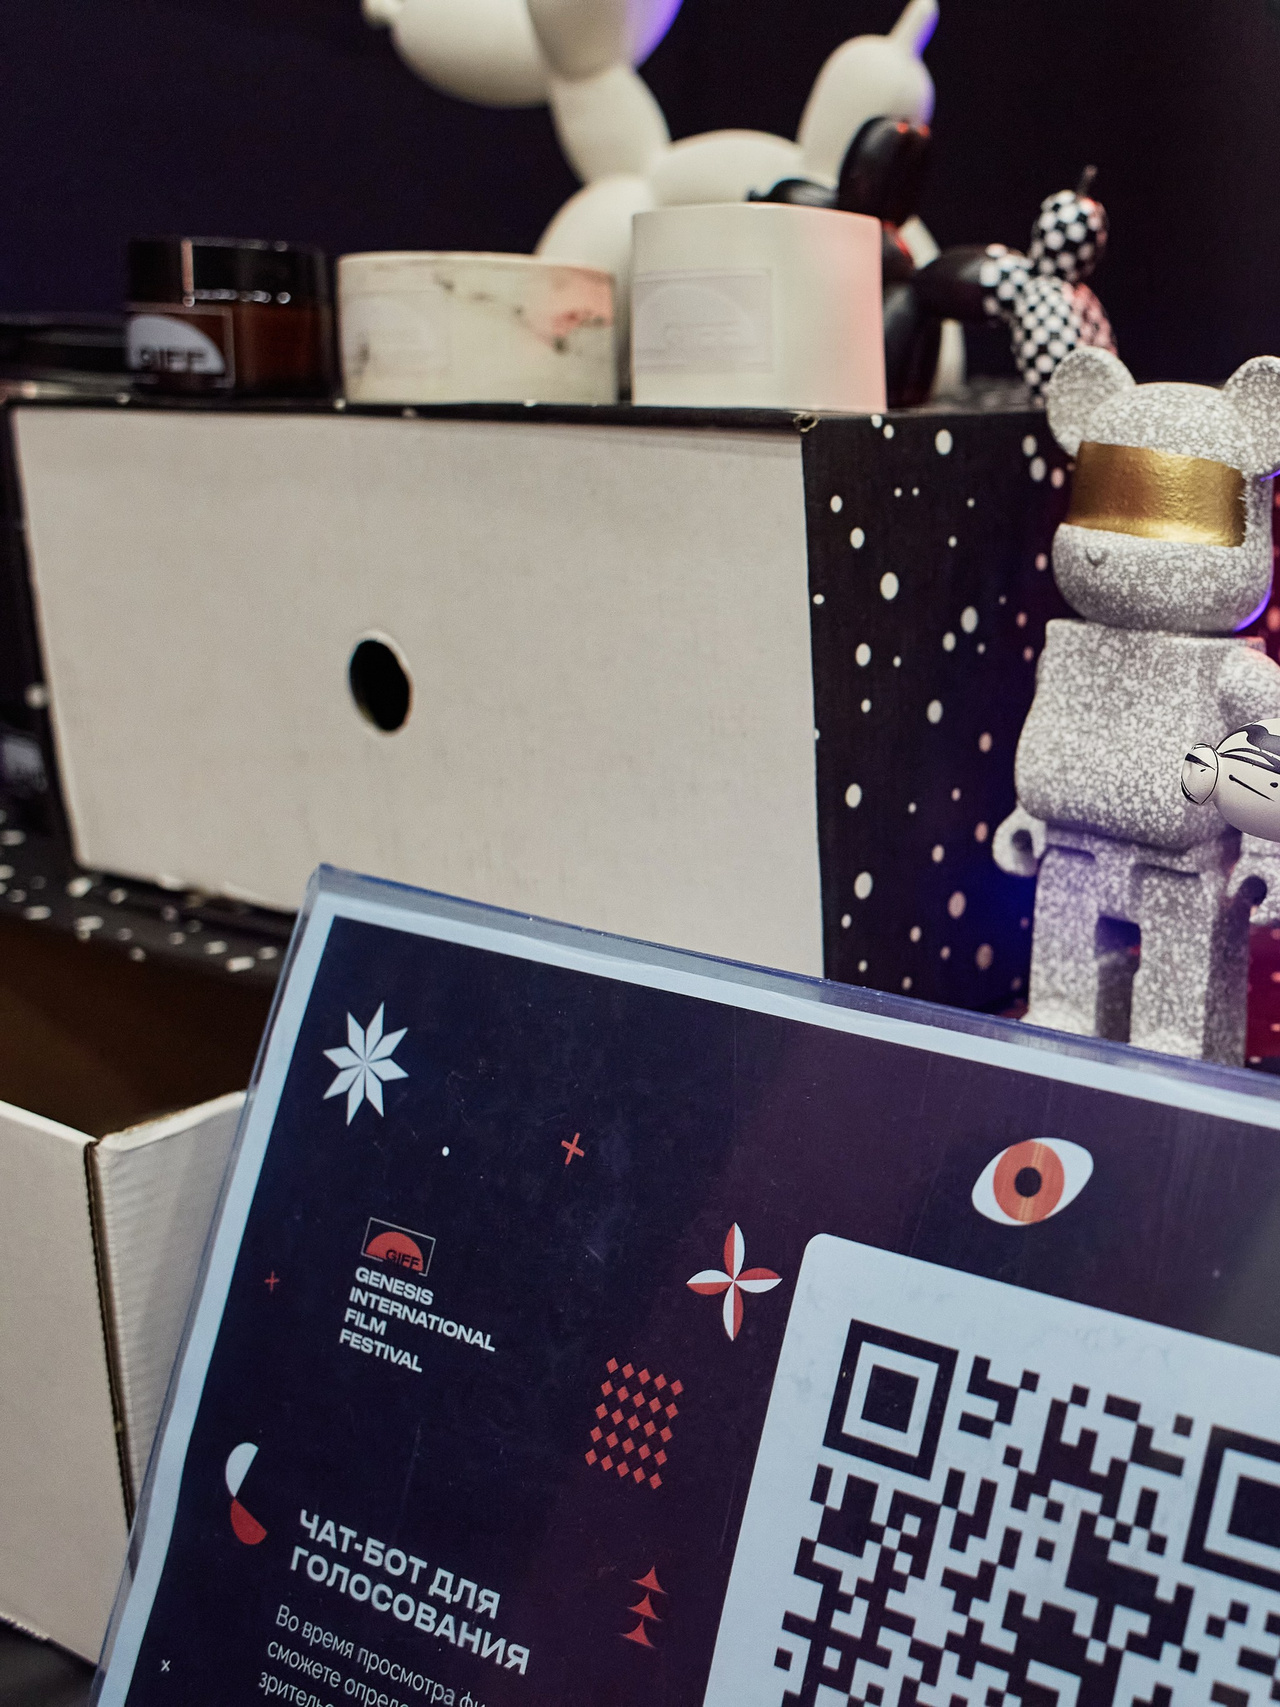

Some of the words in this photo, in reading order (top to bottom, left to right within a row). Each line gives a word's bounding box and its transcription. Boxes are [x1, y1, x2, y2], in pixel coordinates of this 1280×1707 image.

[355, 1266, 434, 1305] GENESIS
[386, 1249, 421, 1269] GIFF
[344, 1307, 387, 1336] FILM
[349, 1286, 496, 1352] INTERNATIONAL
[339, 1328, 422, 1373] FESTIVAL
[300, 1508, 427, 1584] ЧАТ-БОТ
[428, 1567, 500, 1619] ДЛЯ
[290, 1546, 530, 1675] ГОЛОСОВАНИЯ
[267, 1641, 341, 1688] сможете
[344, 1678, 409, 1707] опре
[275, 1604, 300, 1632] Во
[301, 1621, 355, 1659] время
[356, 1648, 456, 1706] просмотра
[258, 1671, 335, 1707] зритель
